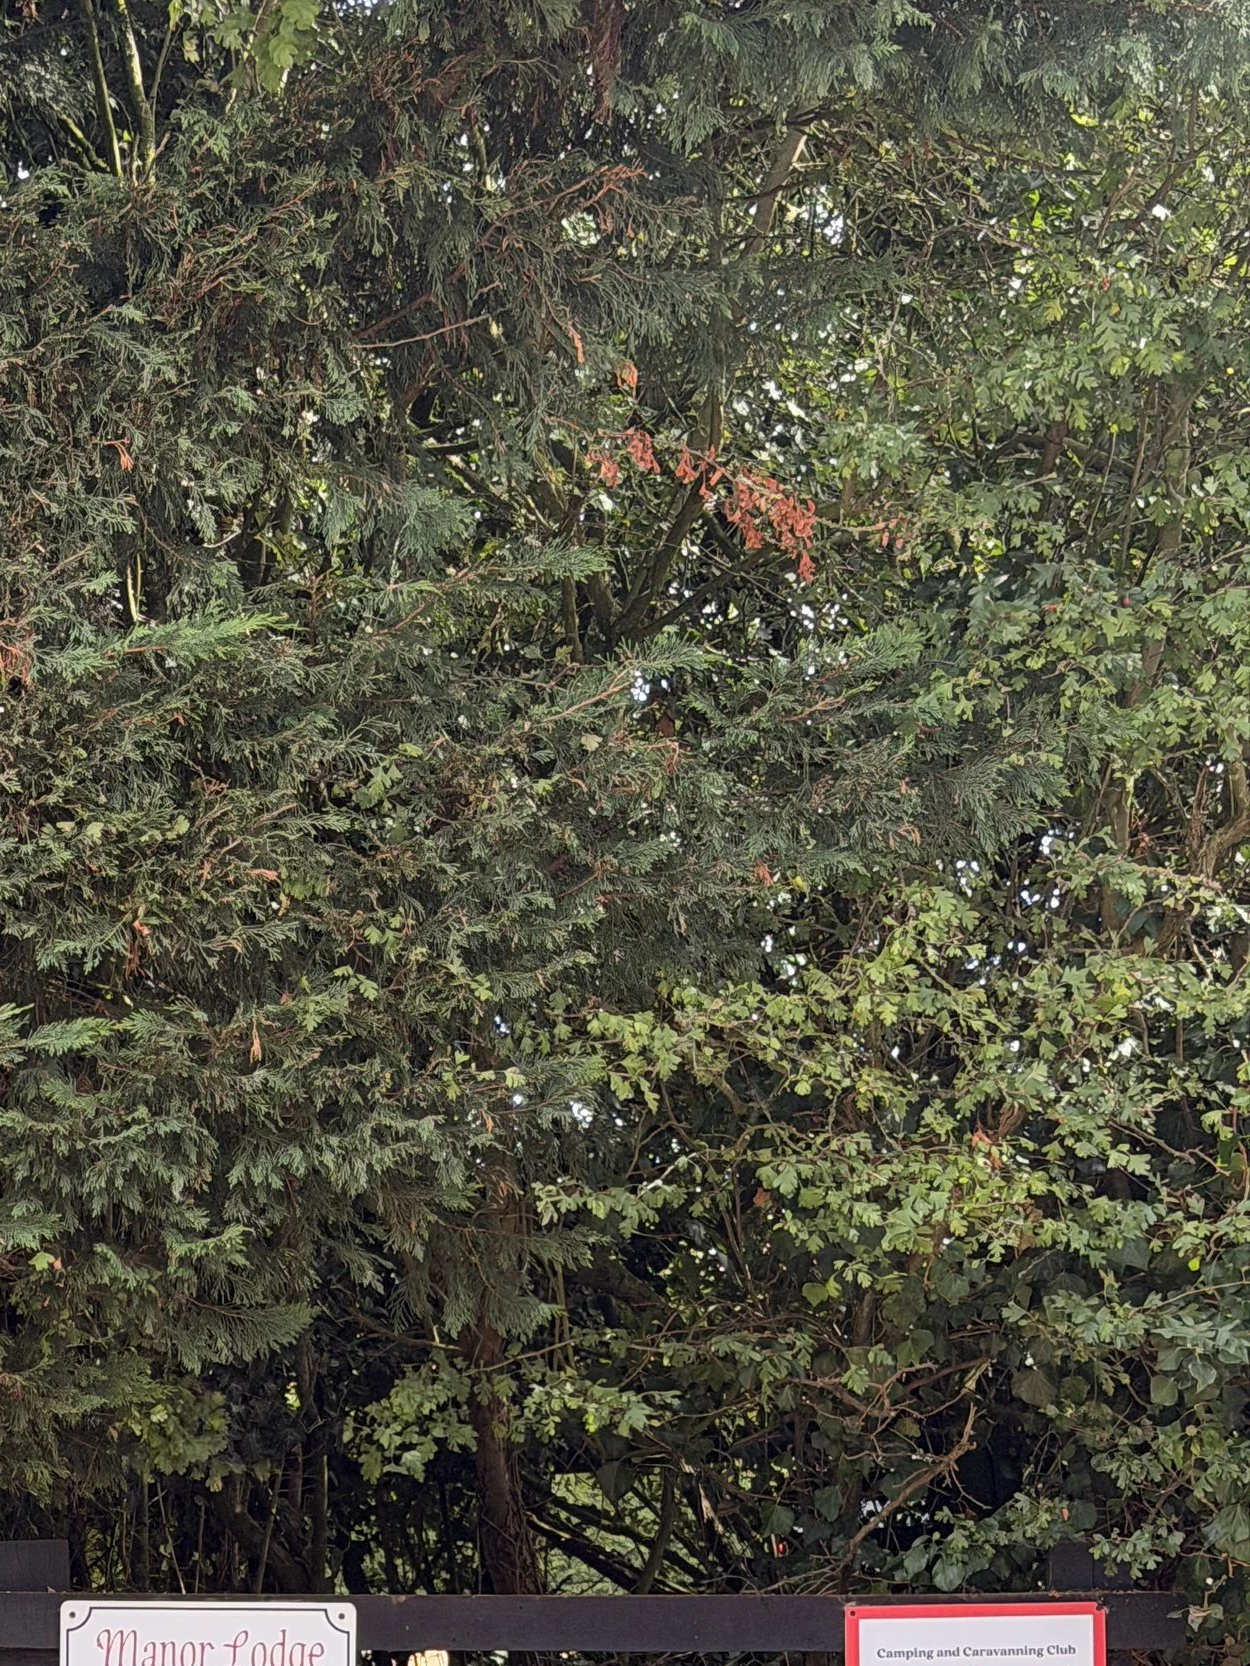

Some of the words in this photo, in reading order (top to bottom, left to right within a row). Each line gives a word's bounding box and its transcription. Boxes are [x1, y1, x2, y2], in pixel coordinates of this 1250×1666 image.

[877, 1647, 934, 1660] Camping
[936, 1646, 960, 1657] and
[963, 1645, 1044, 1658] Caravanning
[1046, 1644, 1076, 1655] Club
